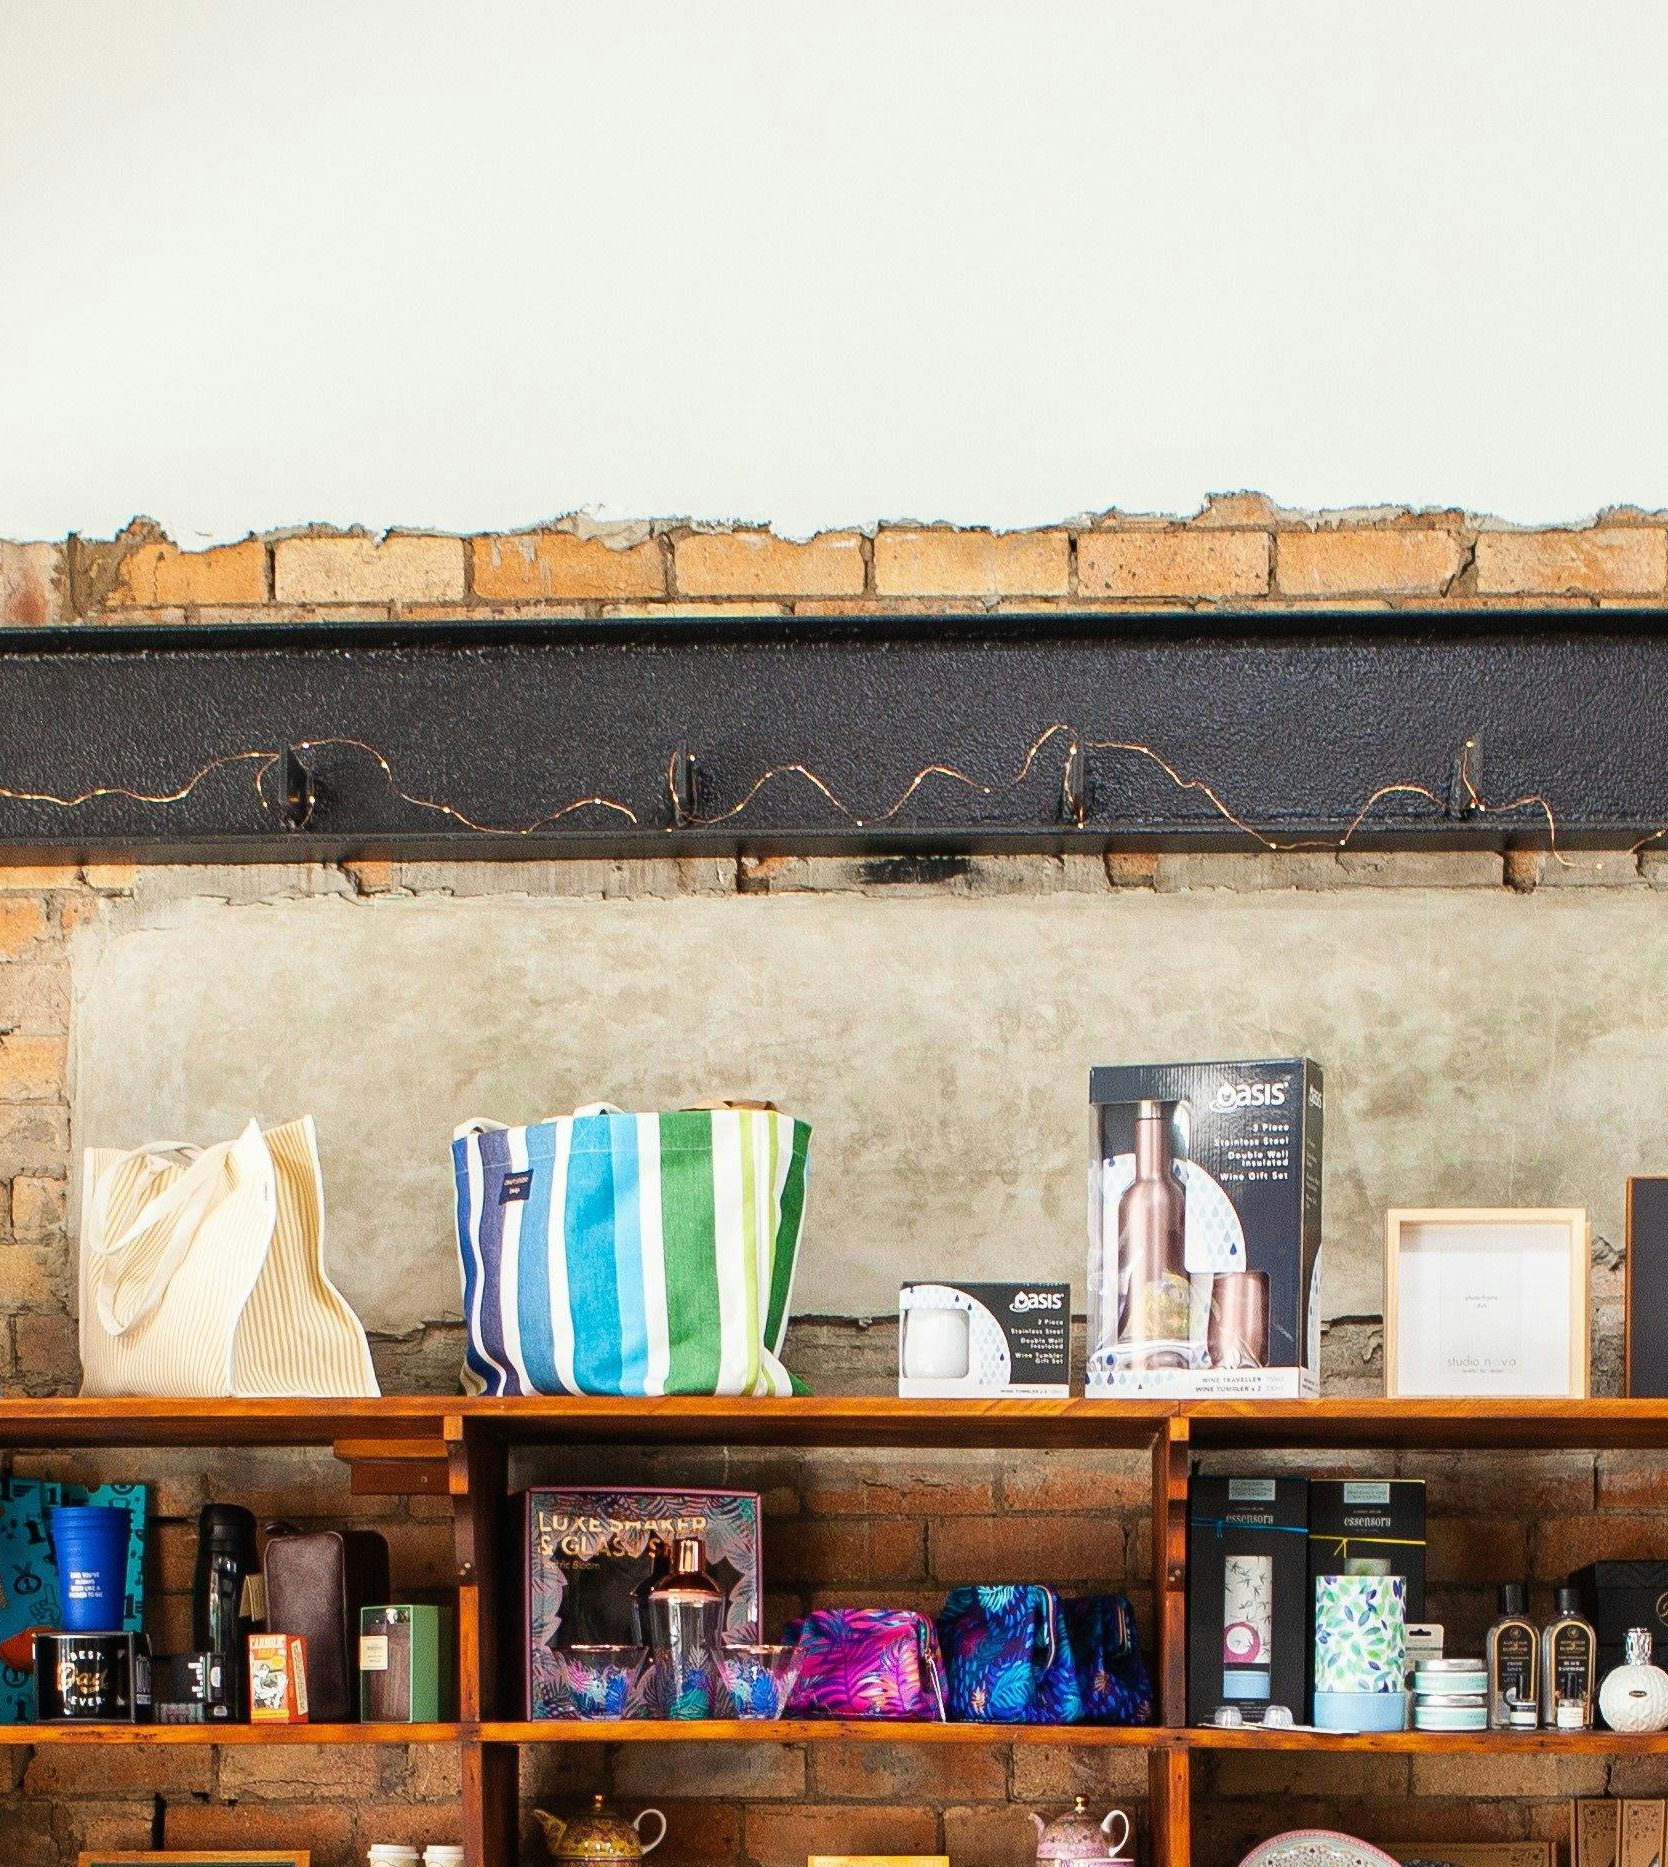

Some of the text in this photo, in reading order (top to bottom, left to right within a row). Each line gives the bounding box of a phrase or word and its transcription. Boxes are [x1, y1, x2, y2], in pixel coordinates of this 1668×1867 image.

[1263, 1123, 1289, 1132] Piece
[1214, 1136, 1289, 1147] Stainless Steel
[1228, 1150, 1289, 1160] Double Wall
[1242, 1159, 1289, 1167] Insulated
[1220, 1172, 1289, 1181] Wine Gift Set
[1447, 1354, 1479, 1368] studio
[1195, 1385, 1249, 1393] WINE TUMBLER
[538, 1511, 707, 1533] LUXE SHAKER
[538, 1535, 553, 1556] &
[68, 1651, 103, 1661] BEST
[70, 1697, 103, 1706] EVER
